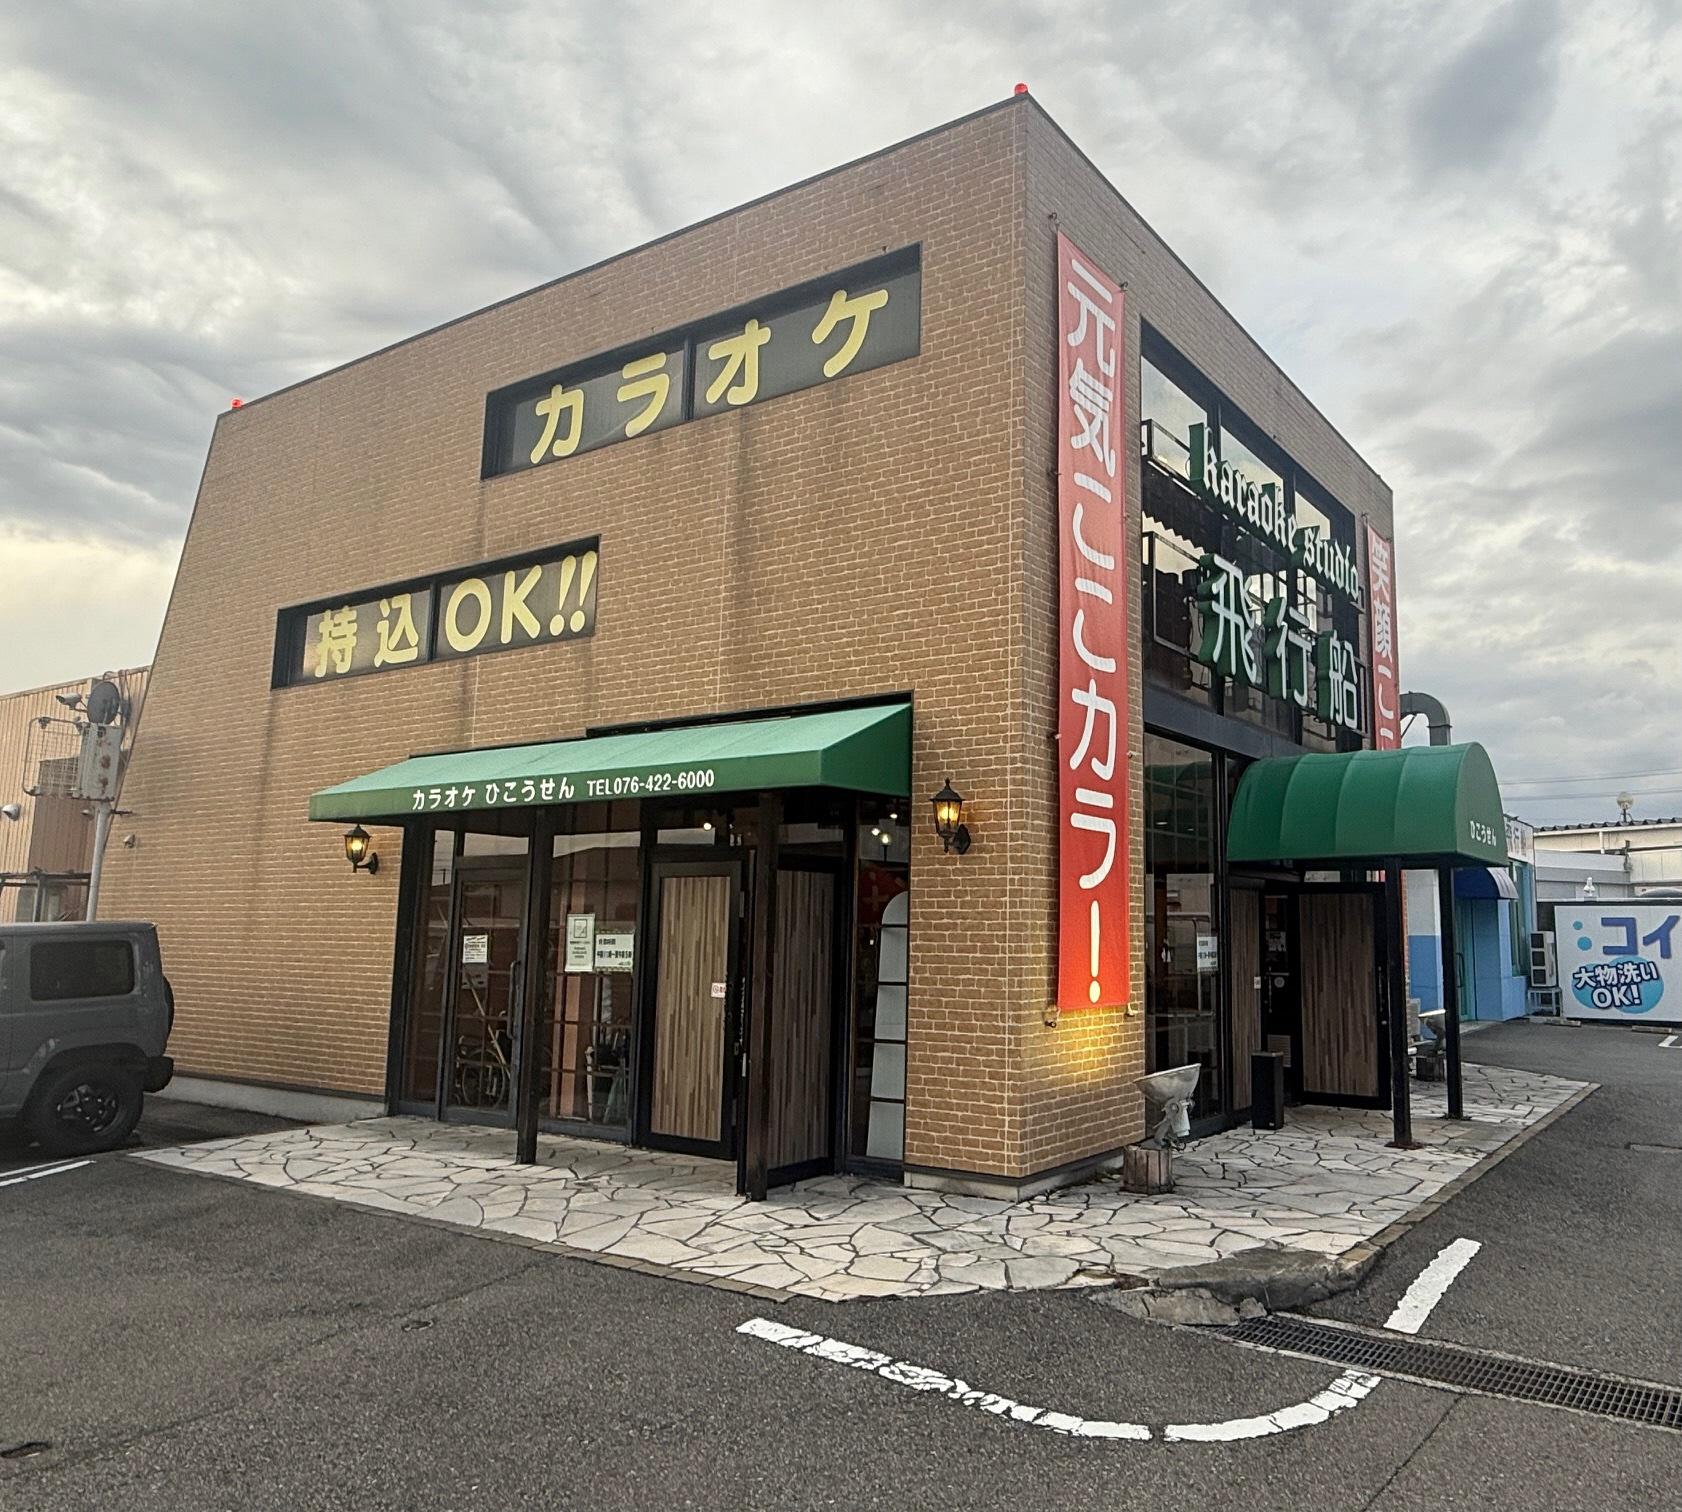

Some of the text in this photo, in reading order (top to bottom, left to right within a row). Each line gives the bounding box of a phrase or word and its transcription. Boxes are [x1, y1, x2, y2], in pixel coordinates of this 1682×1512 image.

[530, 289, 889, 464] カラオケ
[1203, 426, 1359, 600] karaoke studio
[1212, 553, 1360, 730] 飛行船
[412, 787, 476, 810] カラオケ
[485, 777, 575, 804] ひこうせん
[1470, 820, 1497, 847] ひこうせん
[1601, 915, 1680, 959] コイ
[1573, 961, 1658, 989] 大物洗い
[1592, 985, 1643, 1010] OK!
